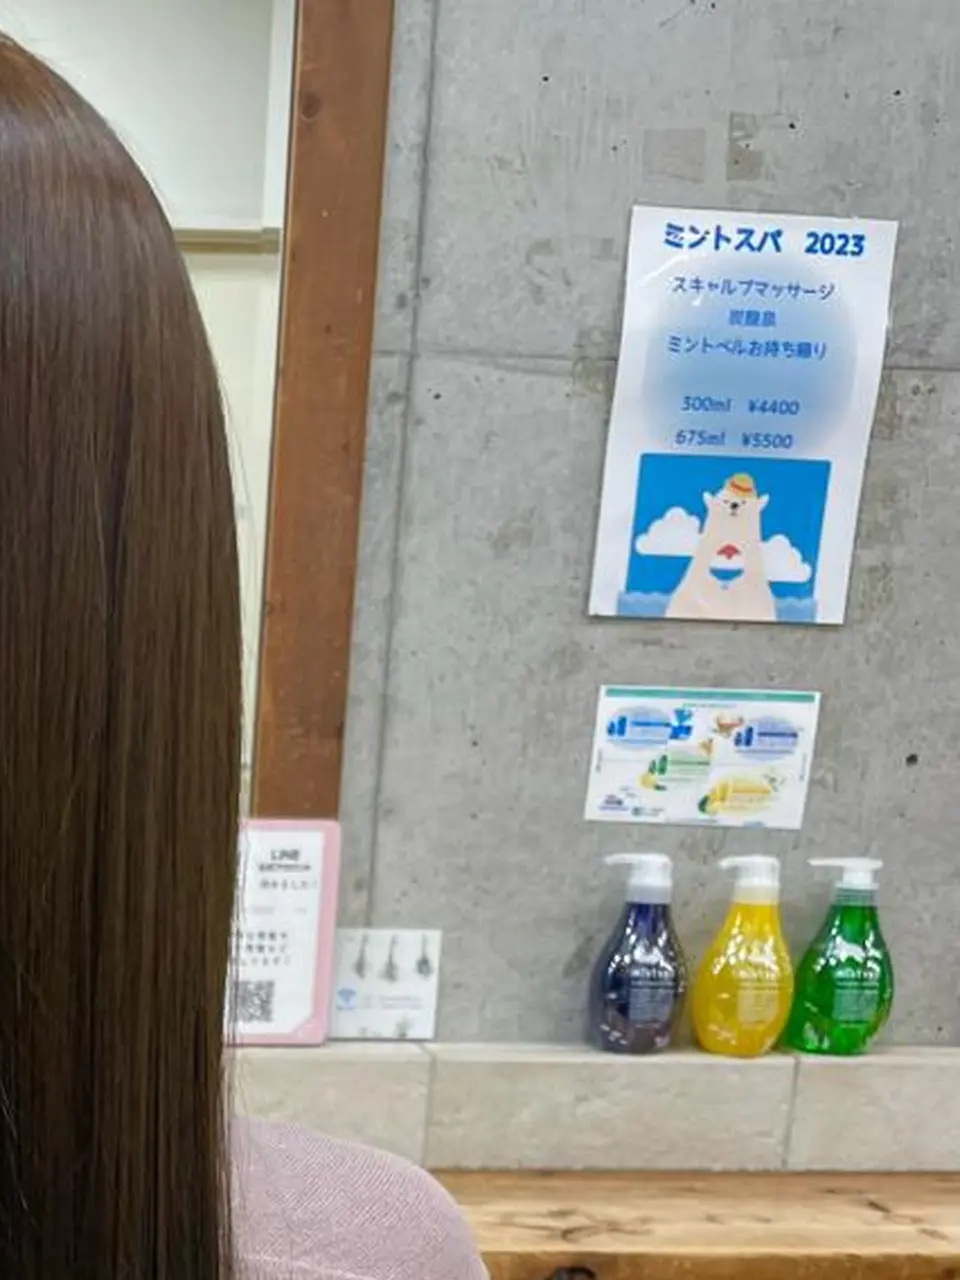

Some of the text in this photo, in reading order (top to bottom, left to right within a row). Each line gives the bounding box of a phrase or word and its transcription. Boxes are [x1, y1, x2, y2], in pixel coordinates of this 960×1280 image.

[663, 222, 866, 256] ミントスパ 2023
[672, 276, 836, 300] スキャルプマッサージ
[748, 399, 800, 415] ¥4400
[741, 432, 793, 449] ¥5500
